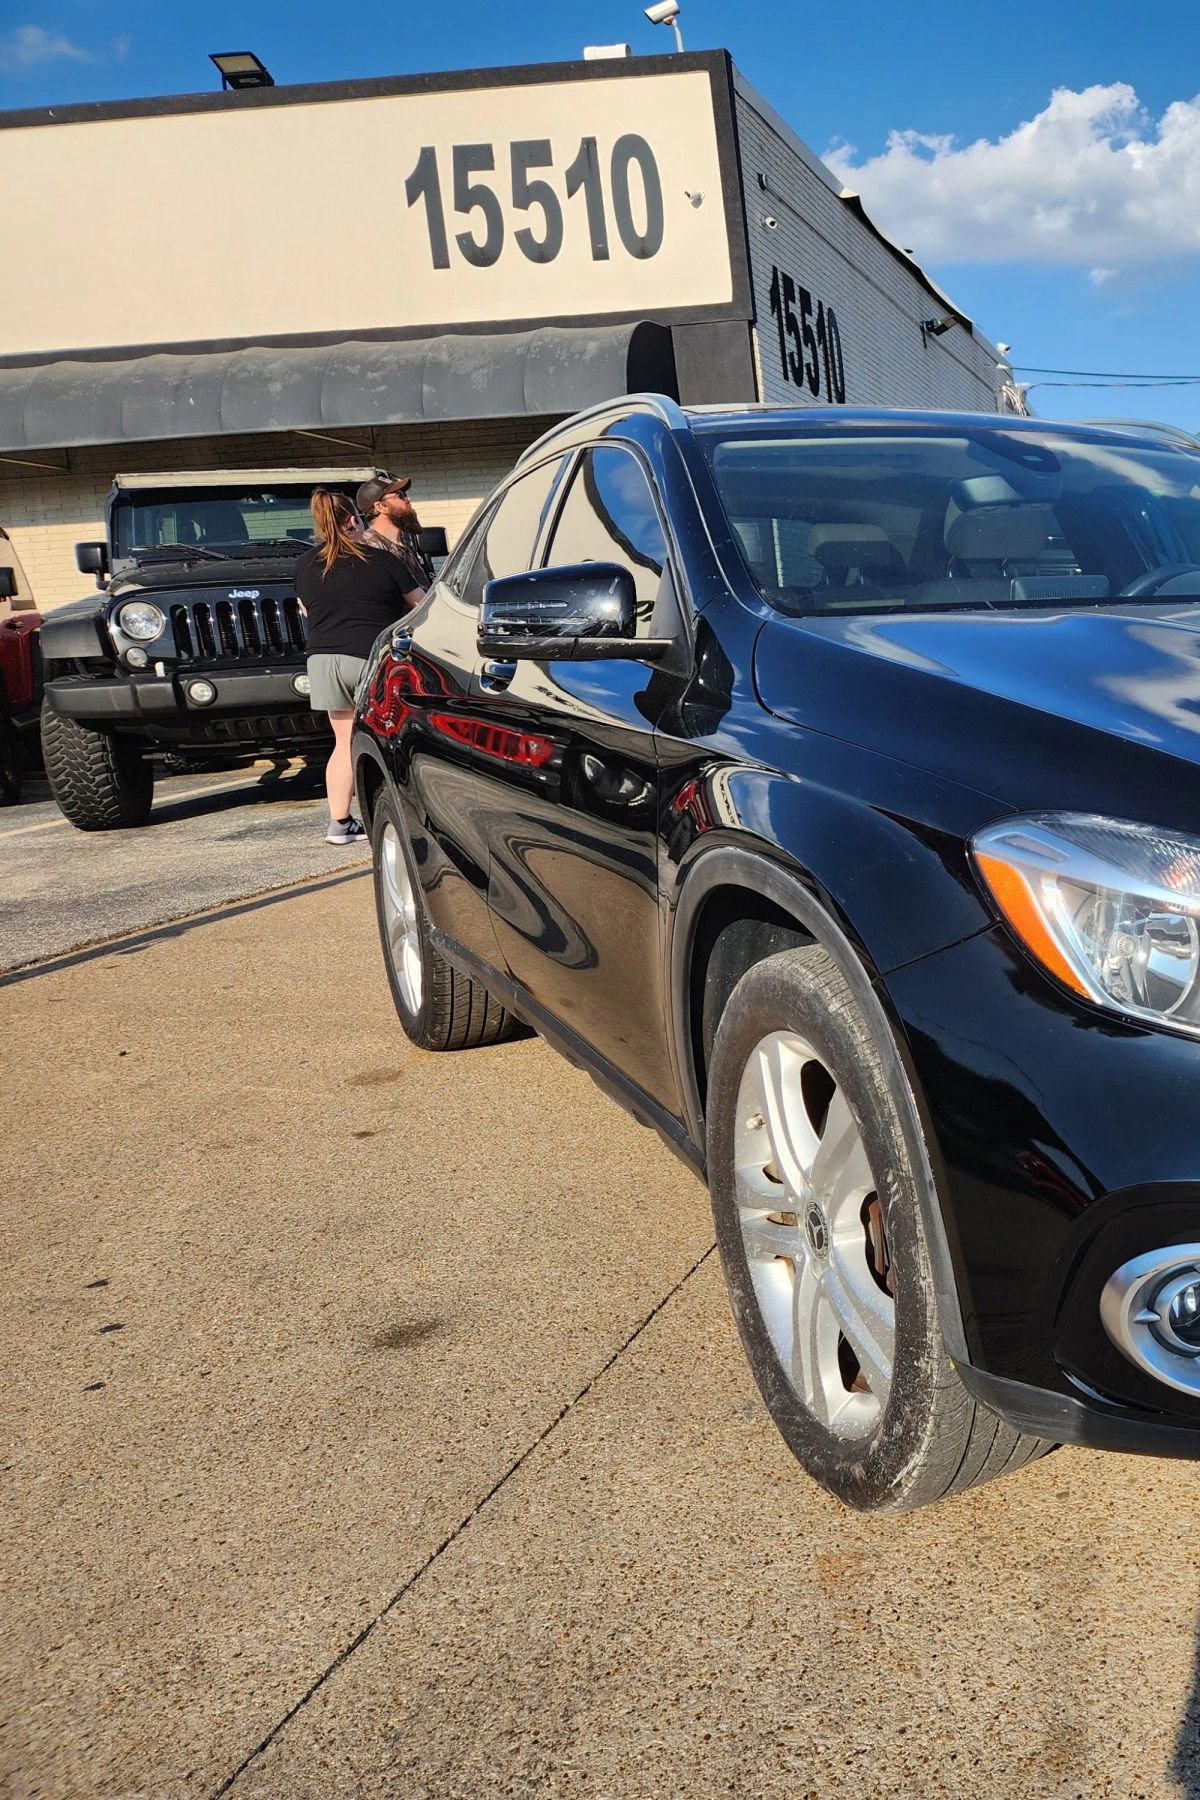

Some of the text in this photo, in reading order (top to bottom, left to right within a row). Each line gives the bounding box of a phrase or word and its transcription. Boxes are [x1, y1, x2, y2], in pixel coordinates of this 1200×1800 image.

[404, 133, 664, 270] 15510
[769, 265, 846, 404] 15510
[228, 589, 260, 599] Jeep
